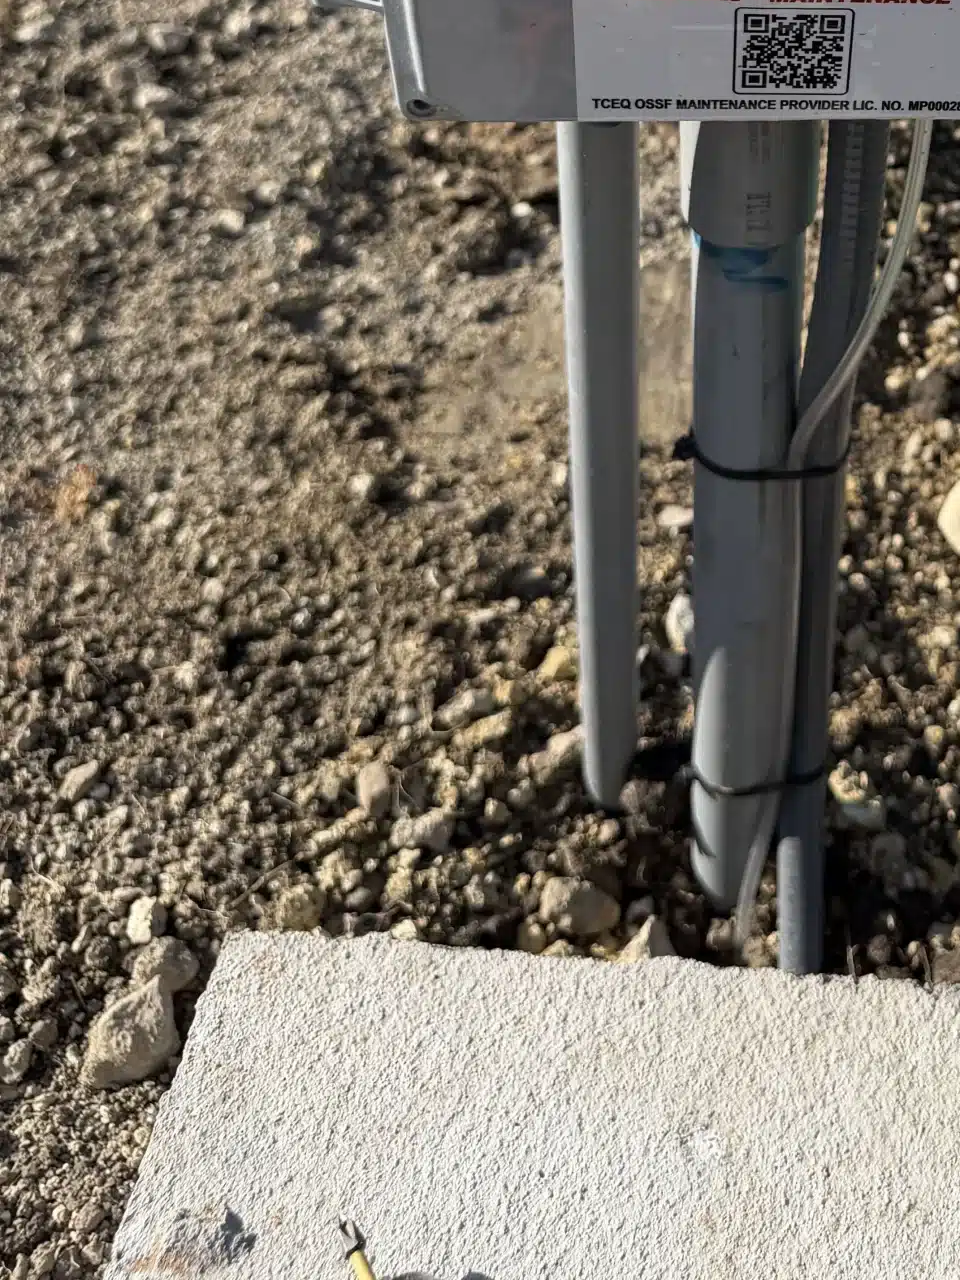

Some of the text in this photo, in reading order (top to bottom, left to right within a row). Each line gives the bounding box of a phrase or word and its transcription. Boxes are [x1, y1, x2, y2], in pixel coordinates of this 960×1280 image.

[592, 99, 631, 109] TCEQ
[635, 99, 672, 109] OSSF
[676, 99, 776, 109] MAINTENANCE
[780, 100, 849, 110] PROVIDER
[853, 100, 877, 110] LIC.
[882, 101, 904, 110] NO.
